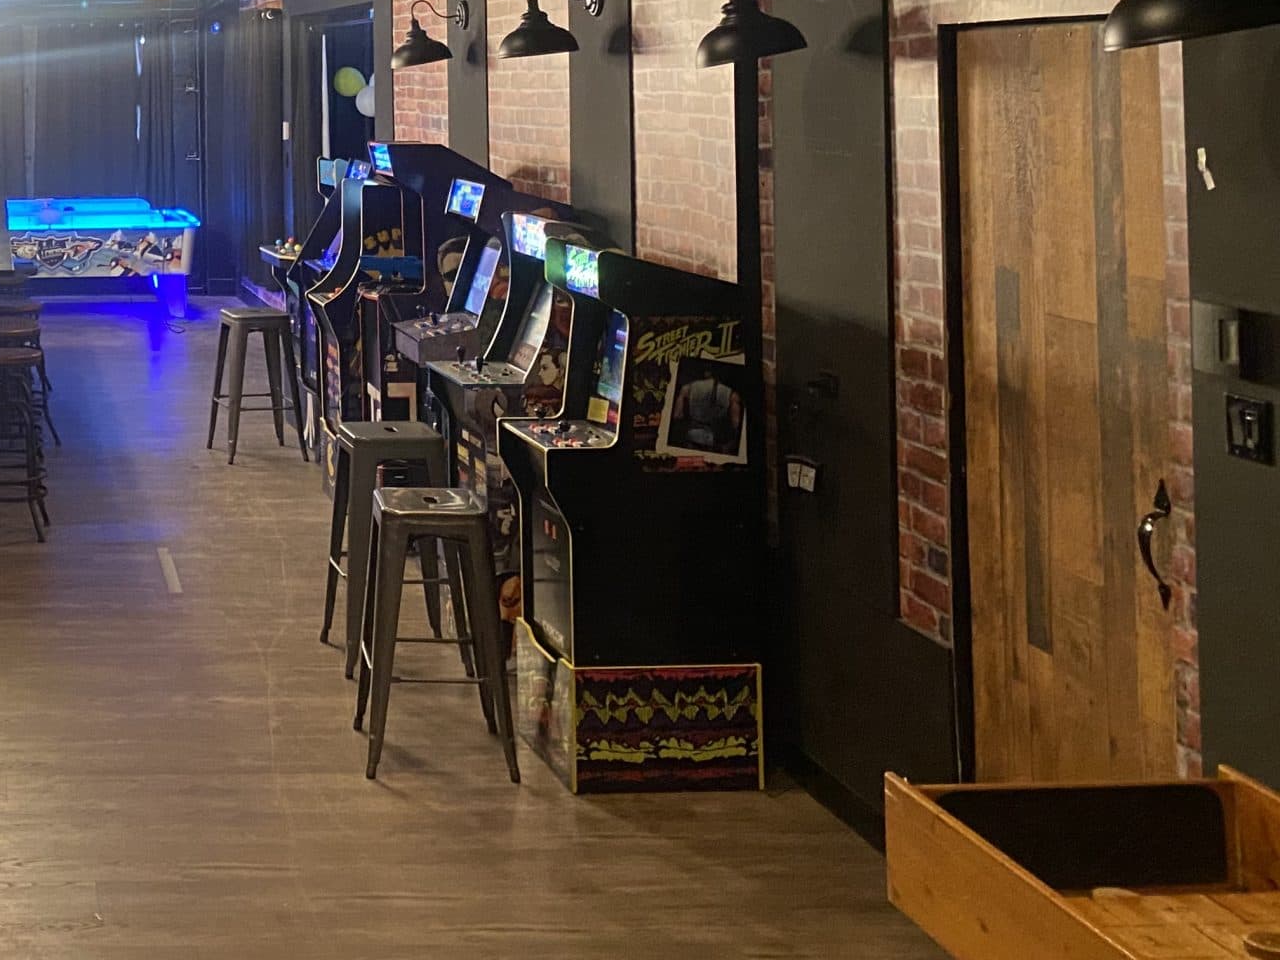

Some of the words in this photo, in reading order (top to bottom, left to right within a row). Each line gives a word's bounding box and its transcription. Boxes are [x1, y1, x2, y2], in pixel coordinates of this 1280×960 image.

[633, 325, 689, 365] STREET
[649, 330, 720, 366] FIGHTER
[717, 320, 741, 357] II
